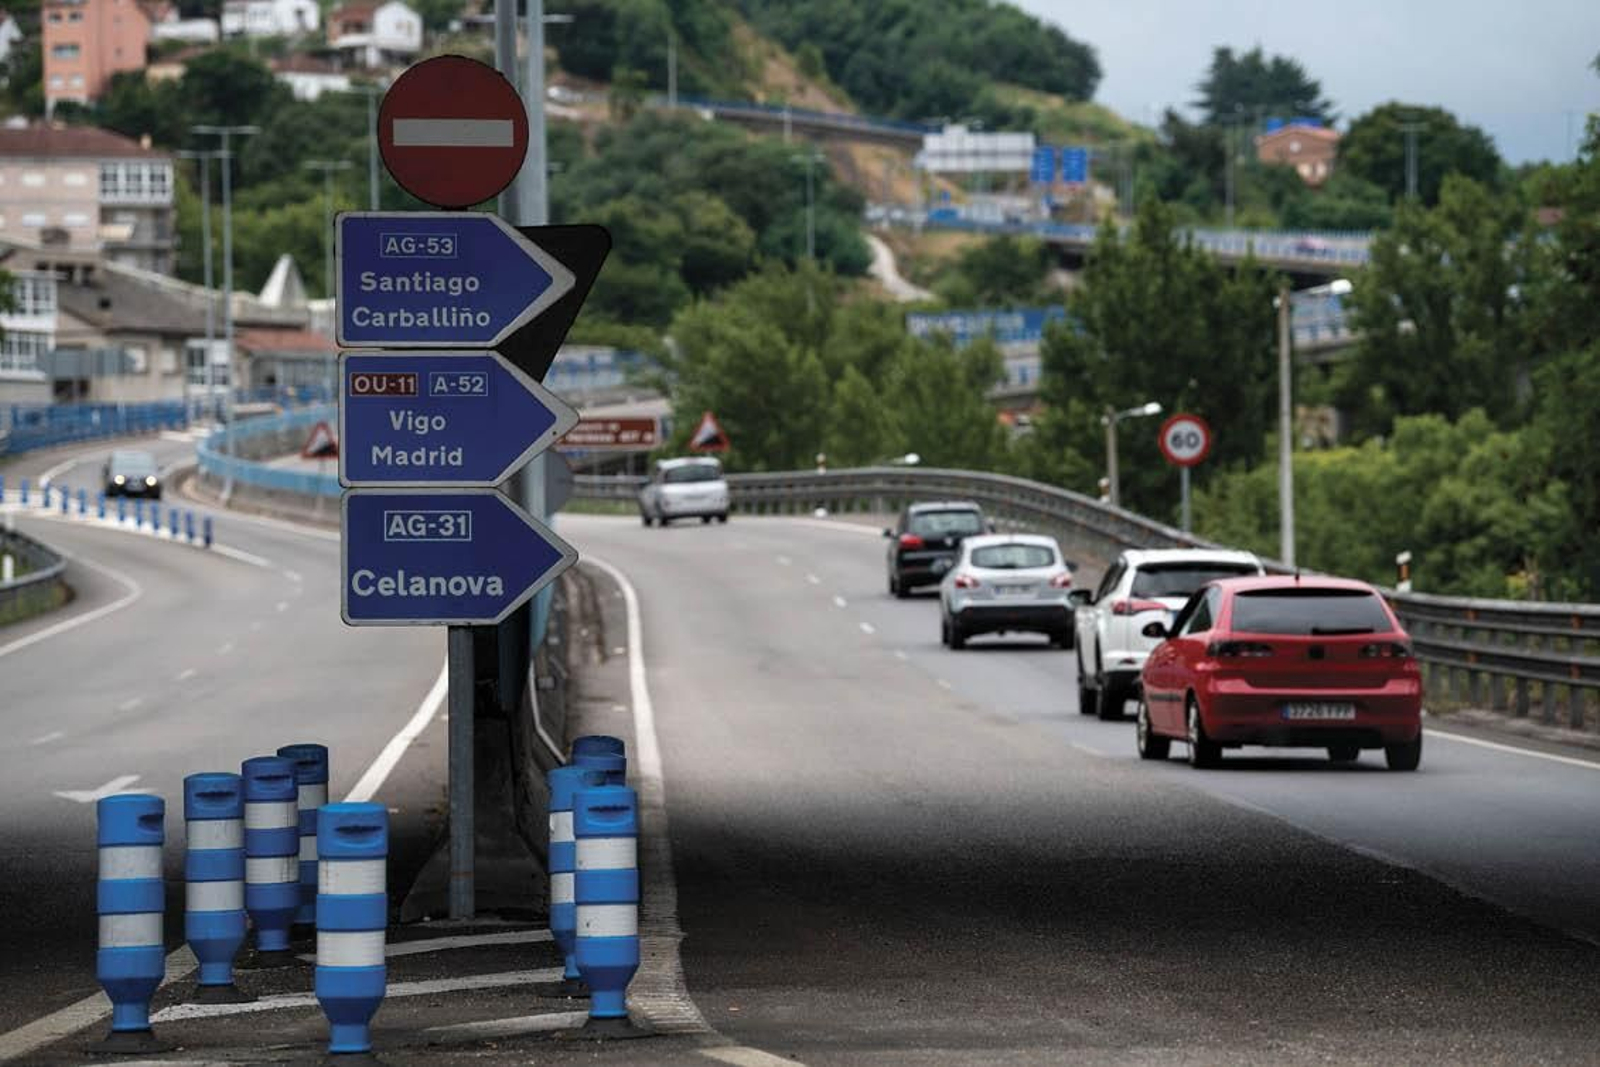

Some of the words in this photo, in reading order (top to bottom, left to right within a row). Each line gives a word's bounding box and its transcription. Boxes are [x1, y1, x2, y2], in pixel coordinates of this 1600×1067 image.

[385, 236, 454, 254] AG-53
[360, 271, 480, 296] Santiago
[352, 307, 491, 328] Carballiño
[354, 376, 415, 393] OU-11
[433, 376, 484, 393] A-52
[389, 410, 447, 435] Vigo
[371, 446, 463, 466] Madrid
[388, 515, 468, 536] AG-31
[351, 569, 504, 597] Celanova
